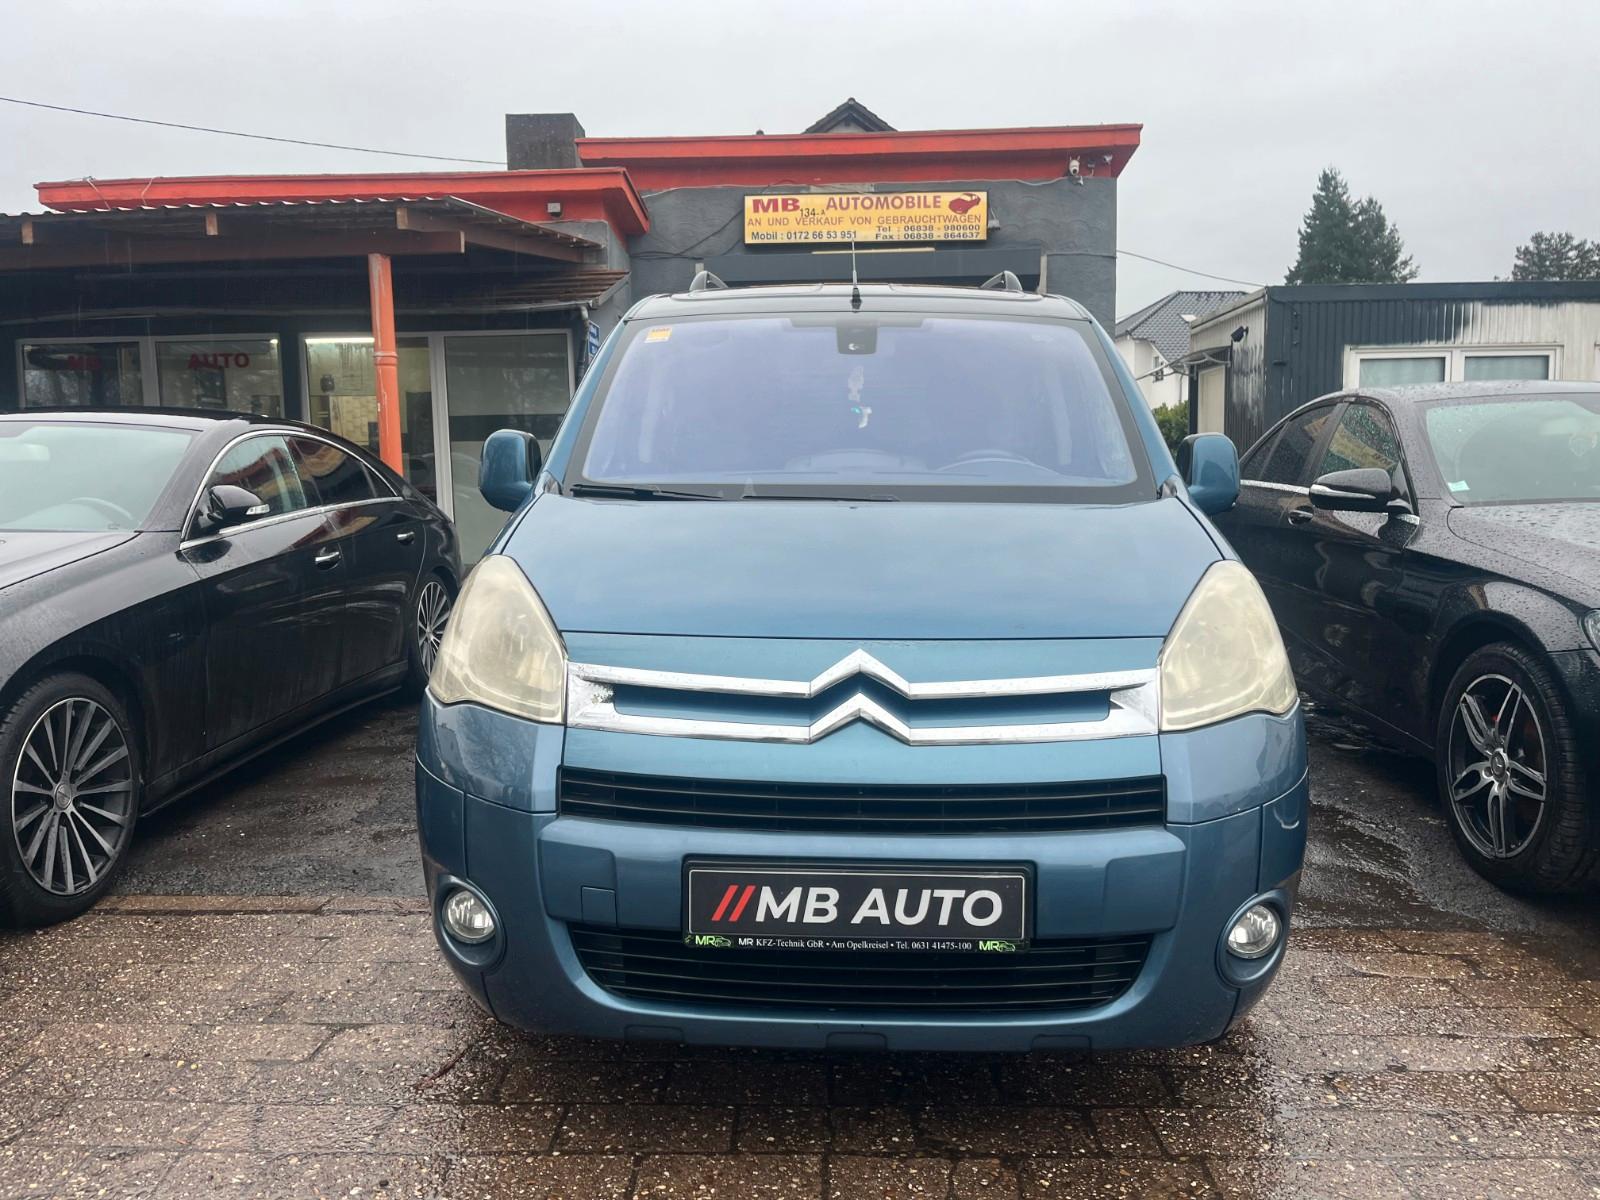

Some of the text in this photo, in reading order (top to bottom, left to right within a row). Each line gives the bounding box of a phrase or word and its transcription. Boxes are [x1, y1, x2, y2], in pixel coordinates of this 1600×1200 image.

[752, 195, 941, 213] MB AUTOMOBILE
[747, 215, 981, 226] AN UND VERKAUF VON GEBRAUCHTWAGEN
[751, 231, 778, 240] Mobil
[786, 231, 808, 240] 0172
[812, 231, 823, 239] 66
[827, 231, 837, 239] 53
[840, 231, 857, 239] 951
[188, 353, 249, 369] AUTO
[850, 887, 1003, 927] AUTO
[695, 935, 999, 951] MR MR KFZ-Technik GbR Am Opelkreisel Tel. 0631 41475-100 MR
